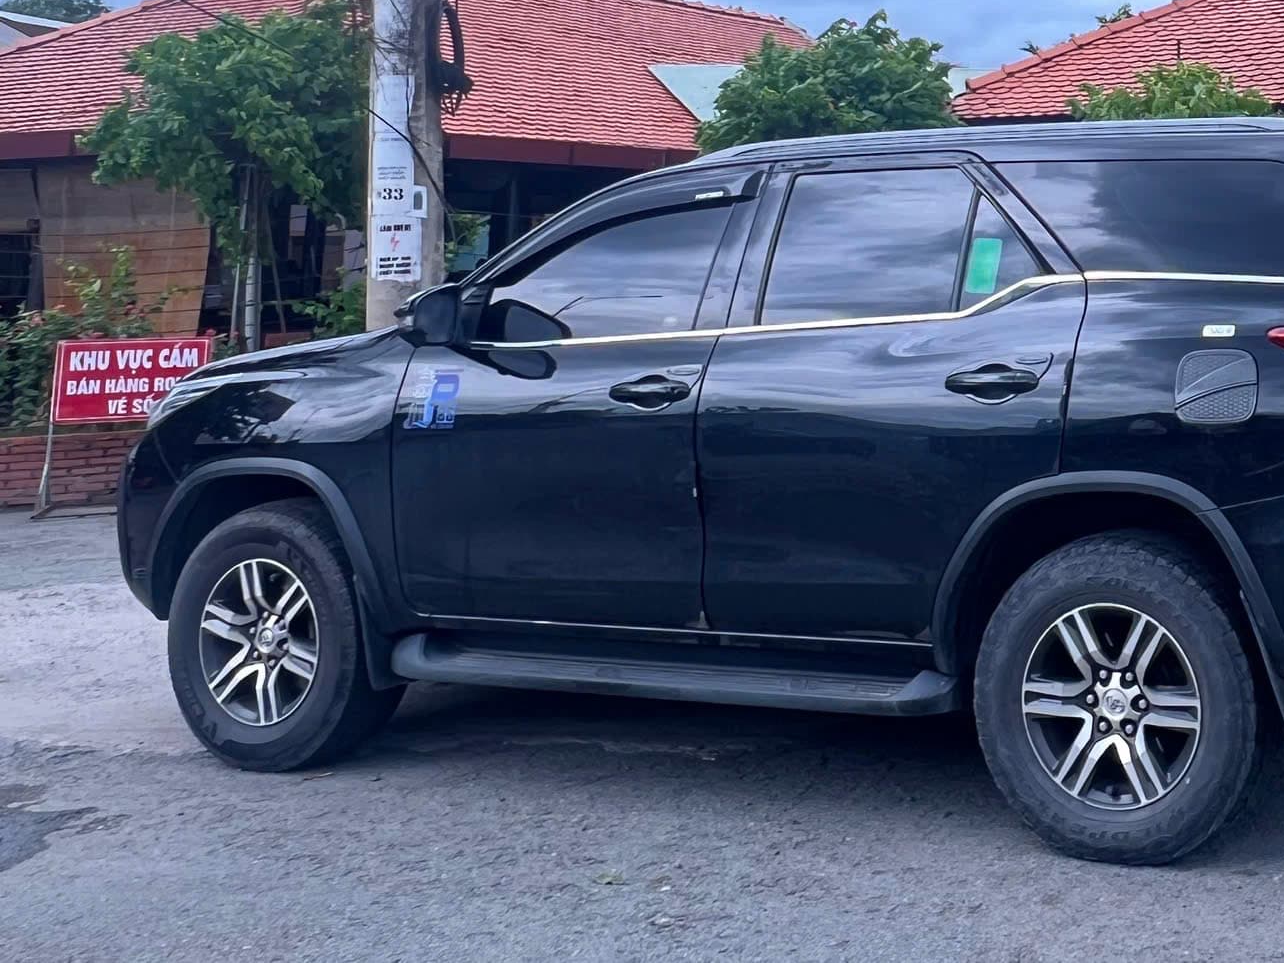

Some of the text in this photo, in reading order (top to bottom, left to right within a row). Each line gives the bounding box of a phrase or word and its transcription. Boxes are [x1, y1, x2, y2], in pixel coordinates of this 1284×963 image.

[69, 350, 111, 372] KHU
[66, 377, 101, 396] BÁN
[105, 375, 149, 394] HÀNG
[107, 396, 128, 415] VÉ
